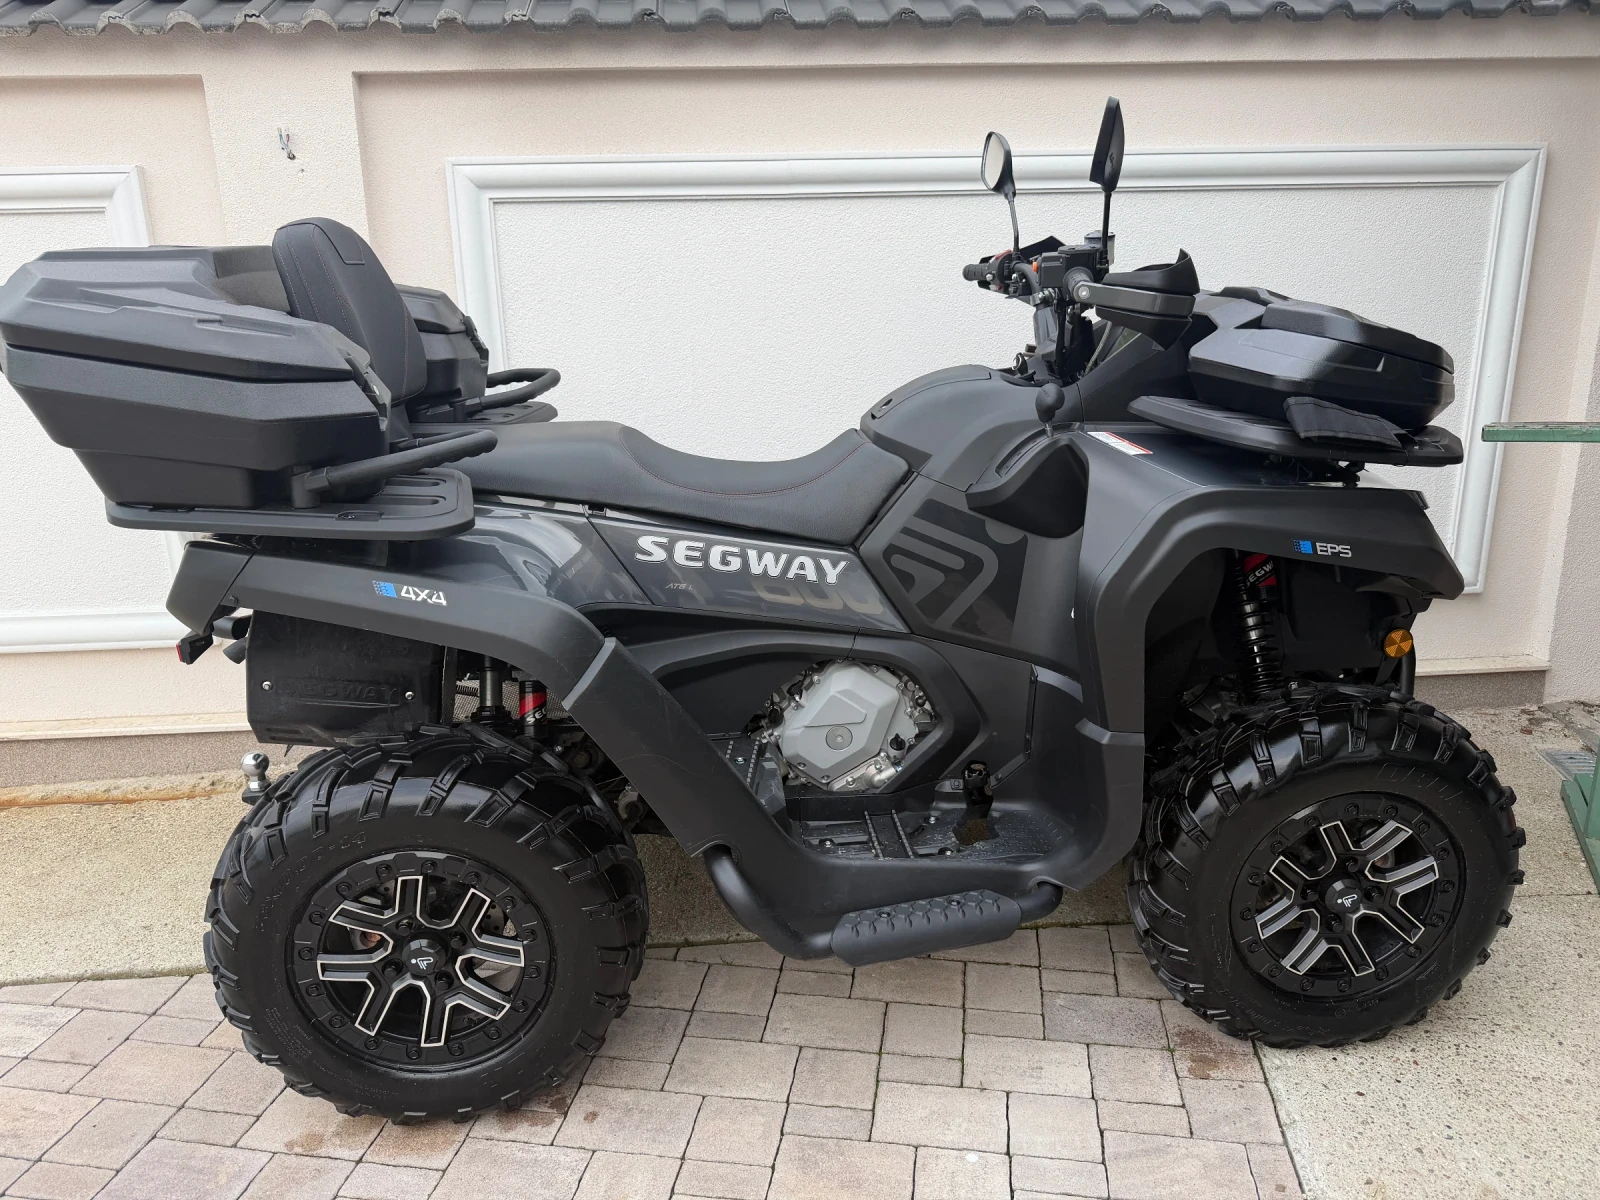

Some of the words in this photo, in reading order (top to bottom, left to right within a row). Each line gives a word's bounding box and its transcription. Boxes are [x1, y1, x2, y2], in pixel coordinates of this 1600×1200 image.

[634, 535, 849, 585] SEGWAY
[1315, 542, 1352, 557] EPS
[400, 585, 447, 606] 4X4
